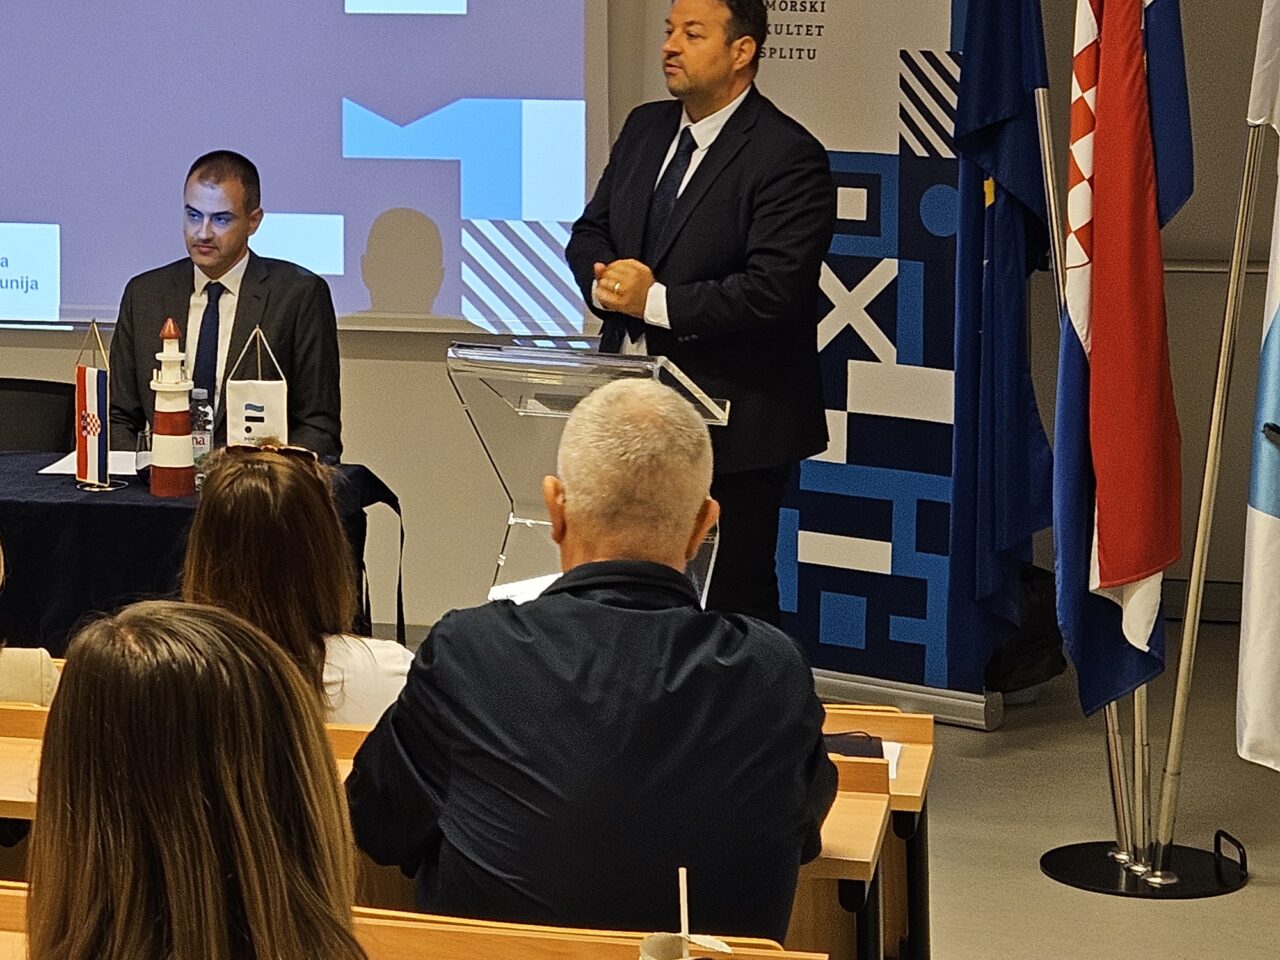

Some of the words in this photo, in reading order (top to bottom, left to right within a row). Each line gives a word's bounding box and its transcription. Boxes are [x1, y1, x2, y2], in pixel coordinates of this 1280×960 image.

[765, 0, 825, 12] MORSKI
[765, 24, 824, 36] KULTET
[760, 47, 816, 59] SPLITU
[0, 276, 39, 294] unija
[191, 435, 205, 446] na
